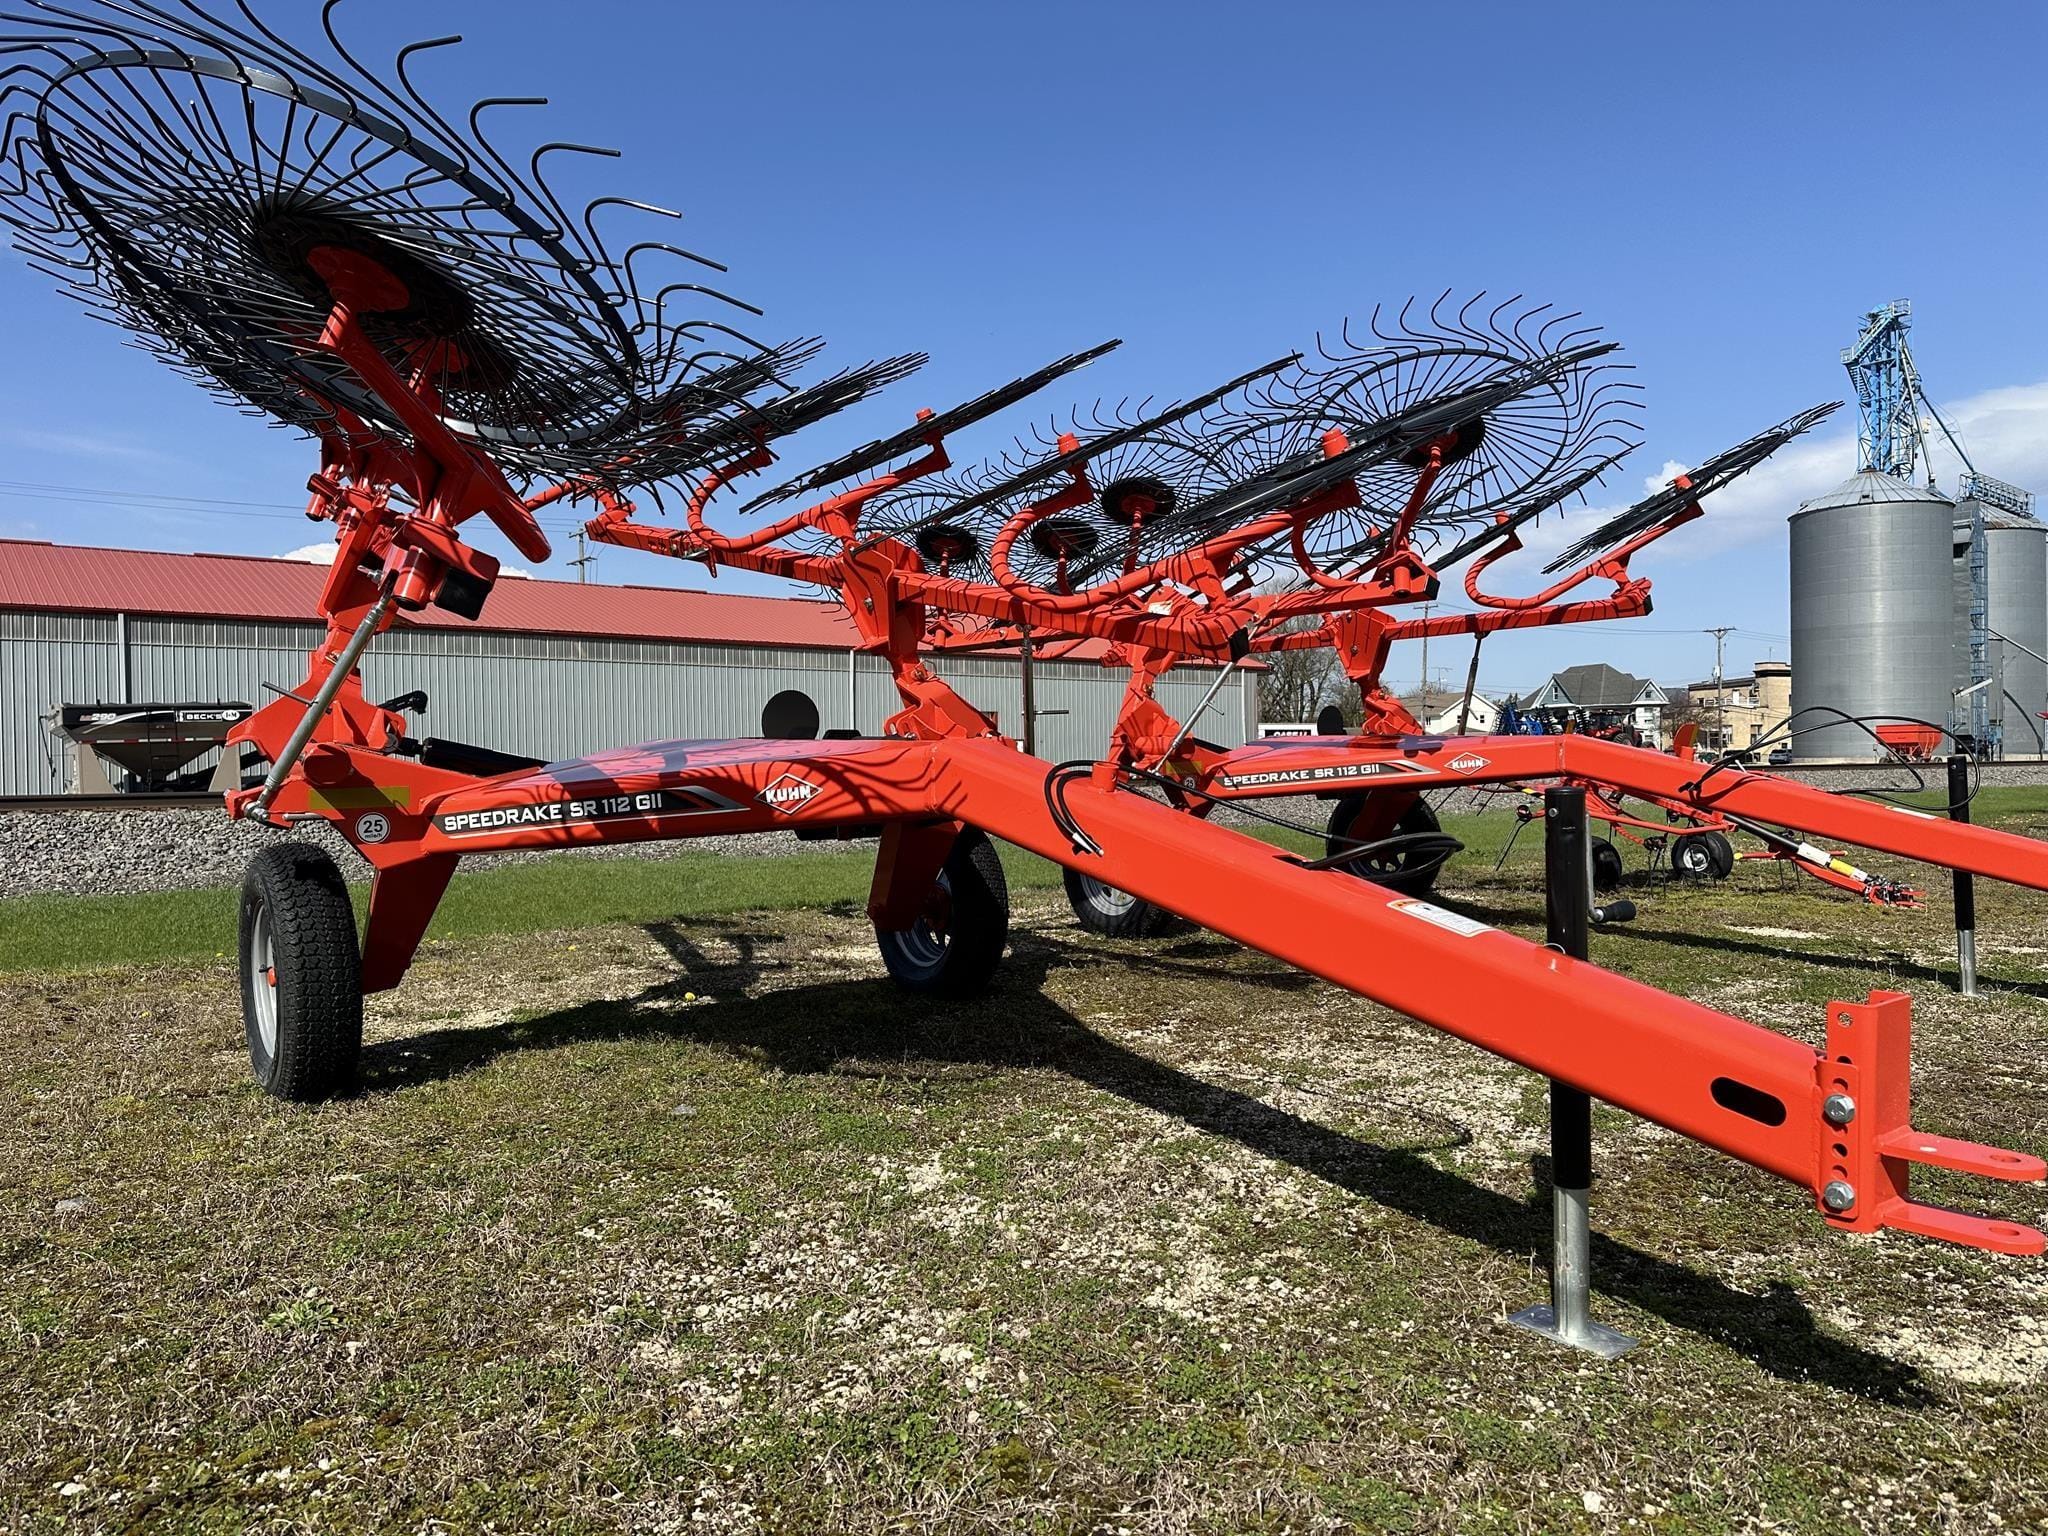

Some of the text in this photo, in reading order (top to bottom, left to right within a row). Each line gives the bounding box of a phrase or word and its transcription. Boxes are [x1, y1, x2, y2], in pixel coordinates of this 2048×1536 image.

[1452, 759, 1483, 769] KUHN
[1223, 764, 1379, 786] SPEEDRAKE SR 112 GII
[765, 785, 811, 803] KUHN
[444, 793, 662, 831] SPEEDRAKE SR 112 GII
[363, 819, 383, 833] 25
